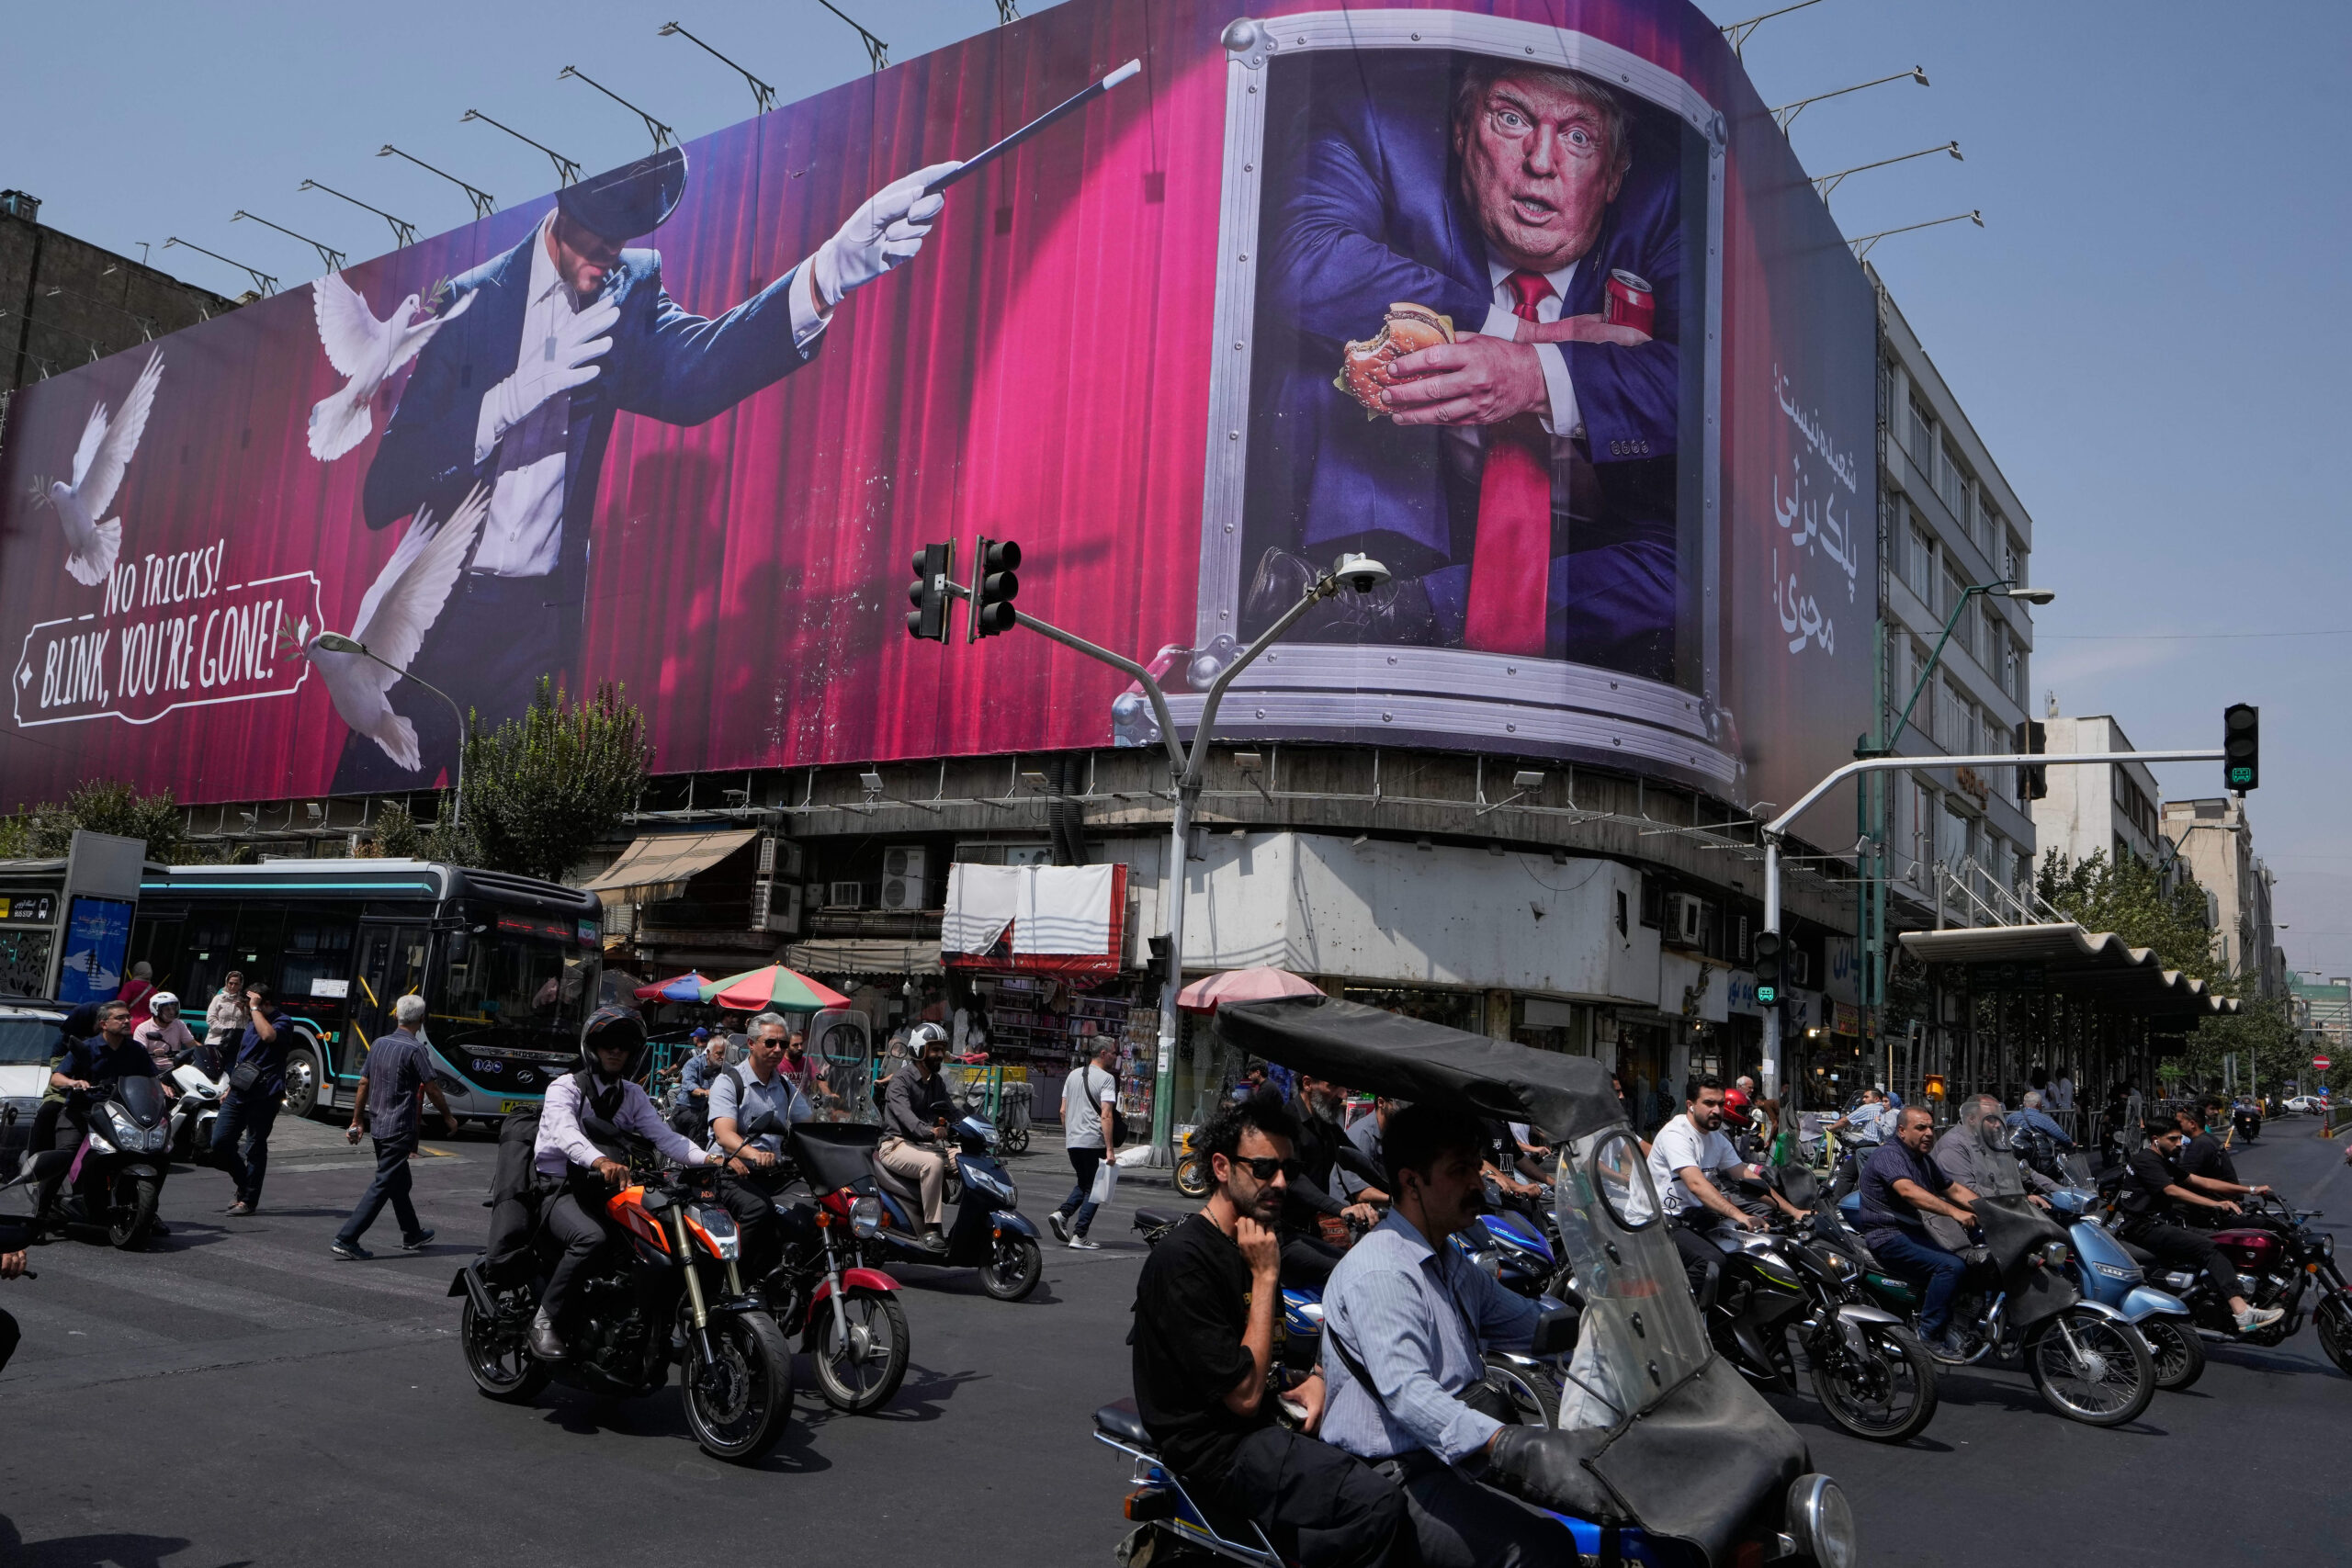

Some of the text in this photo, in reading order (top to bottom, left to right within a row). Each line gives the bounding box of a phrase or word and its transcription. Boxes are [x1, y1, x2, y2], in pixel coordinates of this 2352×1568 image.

[103, 538, 224, 617] NO TRICKS!
[1773, 454, 1857, 604] پلک بزنی
[40, 598, 283, 707] BLINK, YOU'RE GONE!
